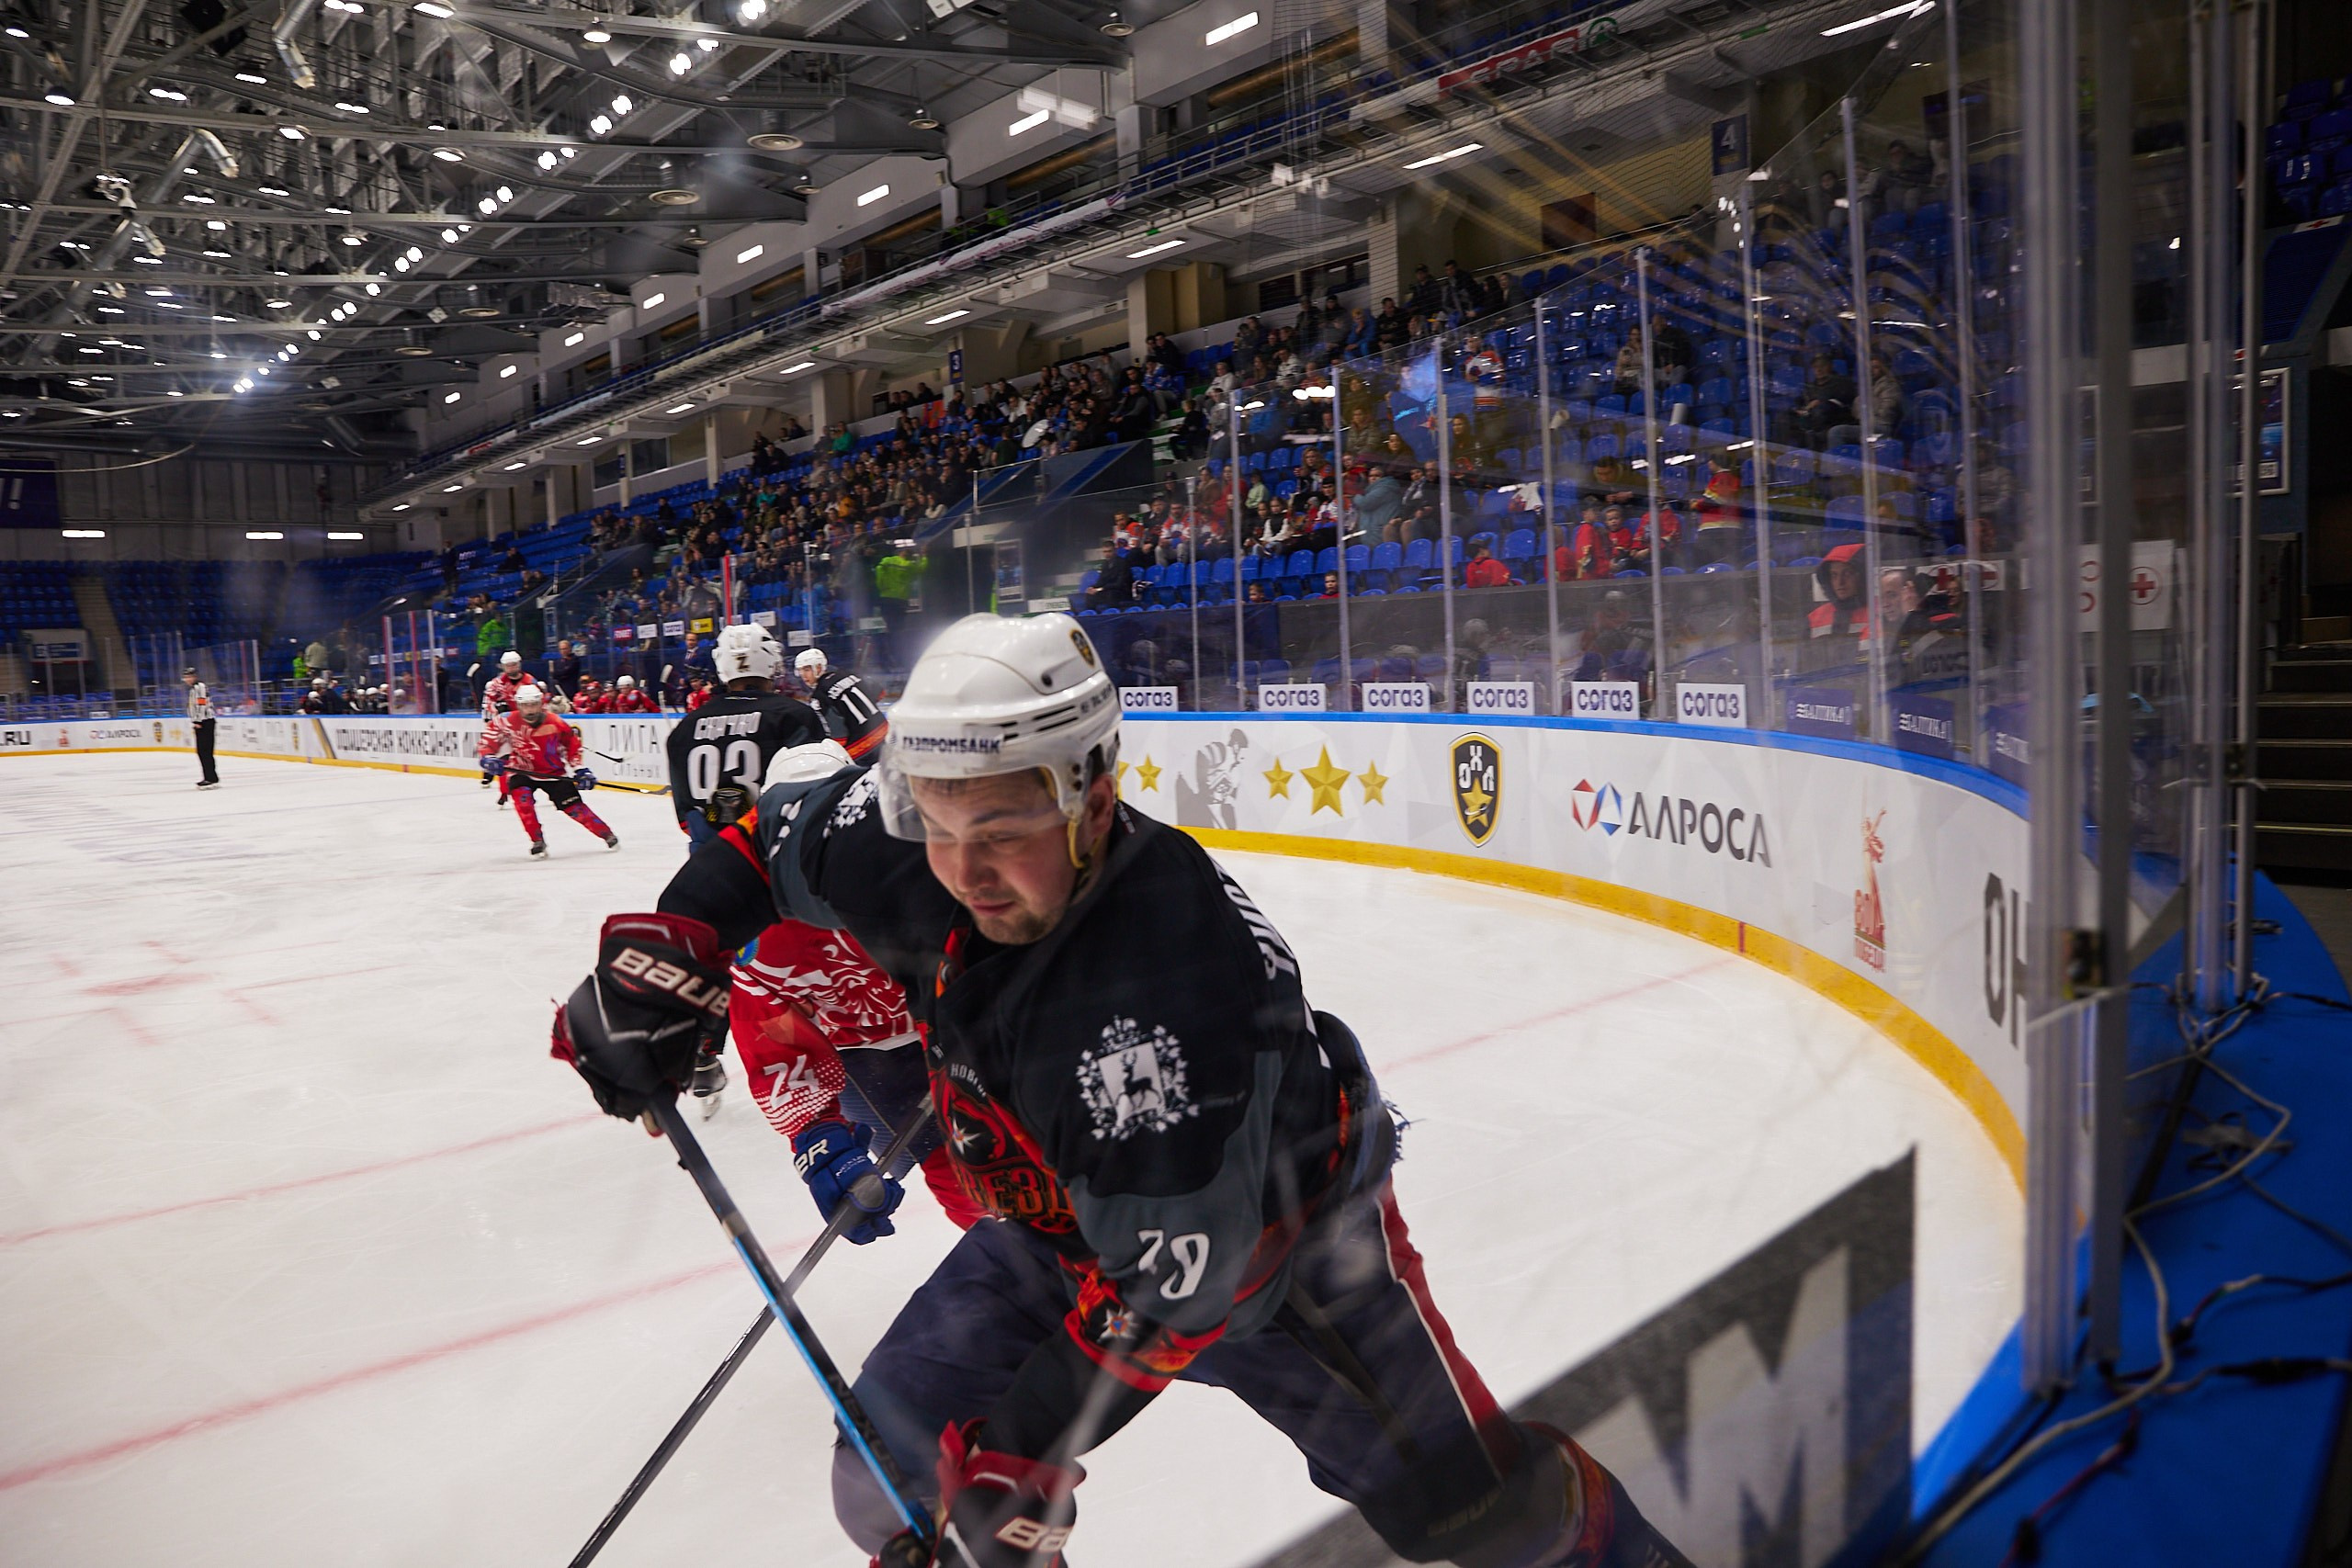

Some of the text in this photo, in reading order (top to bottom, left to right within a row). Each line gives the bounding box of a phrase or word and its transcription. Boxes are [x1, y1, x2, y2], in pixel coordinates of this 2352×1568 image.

[1720, 124, 1736, 150] 4
[841, 686, 879, 725] 11
[608, 724, 662, 754] ЛИГА
[763, 1055, 821, 1111] 24
[1137, 1229, 1210, 1300] 79
